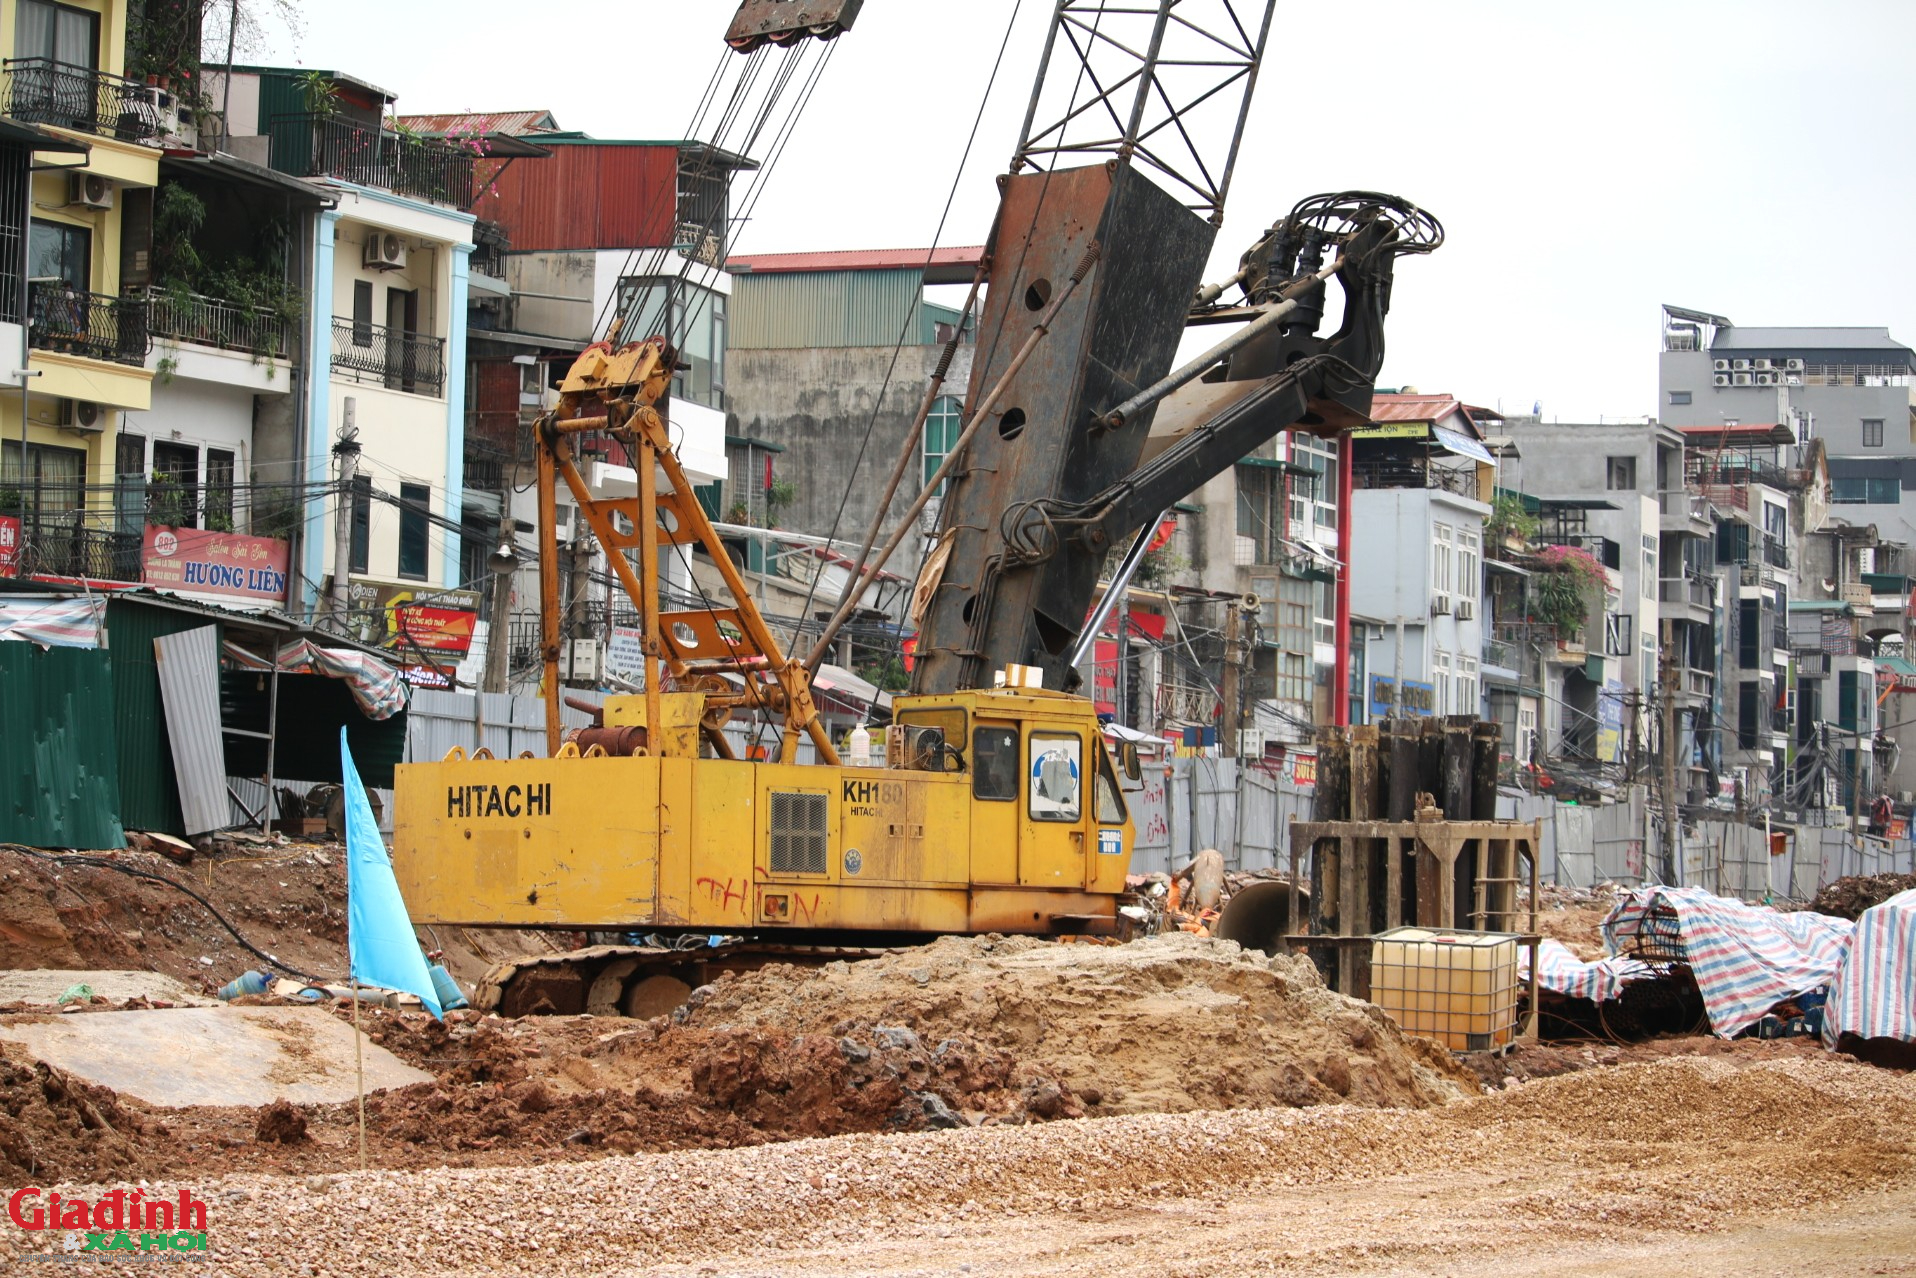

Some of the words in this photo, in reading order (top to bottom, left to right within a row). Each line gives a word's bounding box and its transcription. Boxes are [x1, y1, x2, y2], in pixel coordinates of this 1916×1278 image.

[206, 538, 229, 557] Salon
[184, 561, 244, 589] HƯƠNG
[248, 564, 286, 593] LIÊN
[447, 783, 551, 818] HITACHI
[843, 780, 903, 805] KH180
[850, 806, 883, 818] HITACHI
